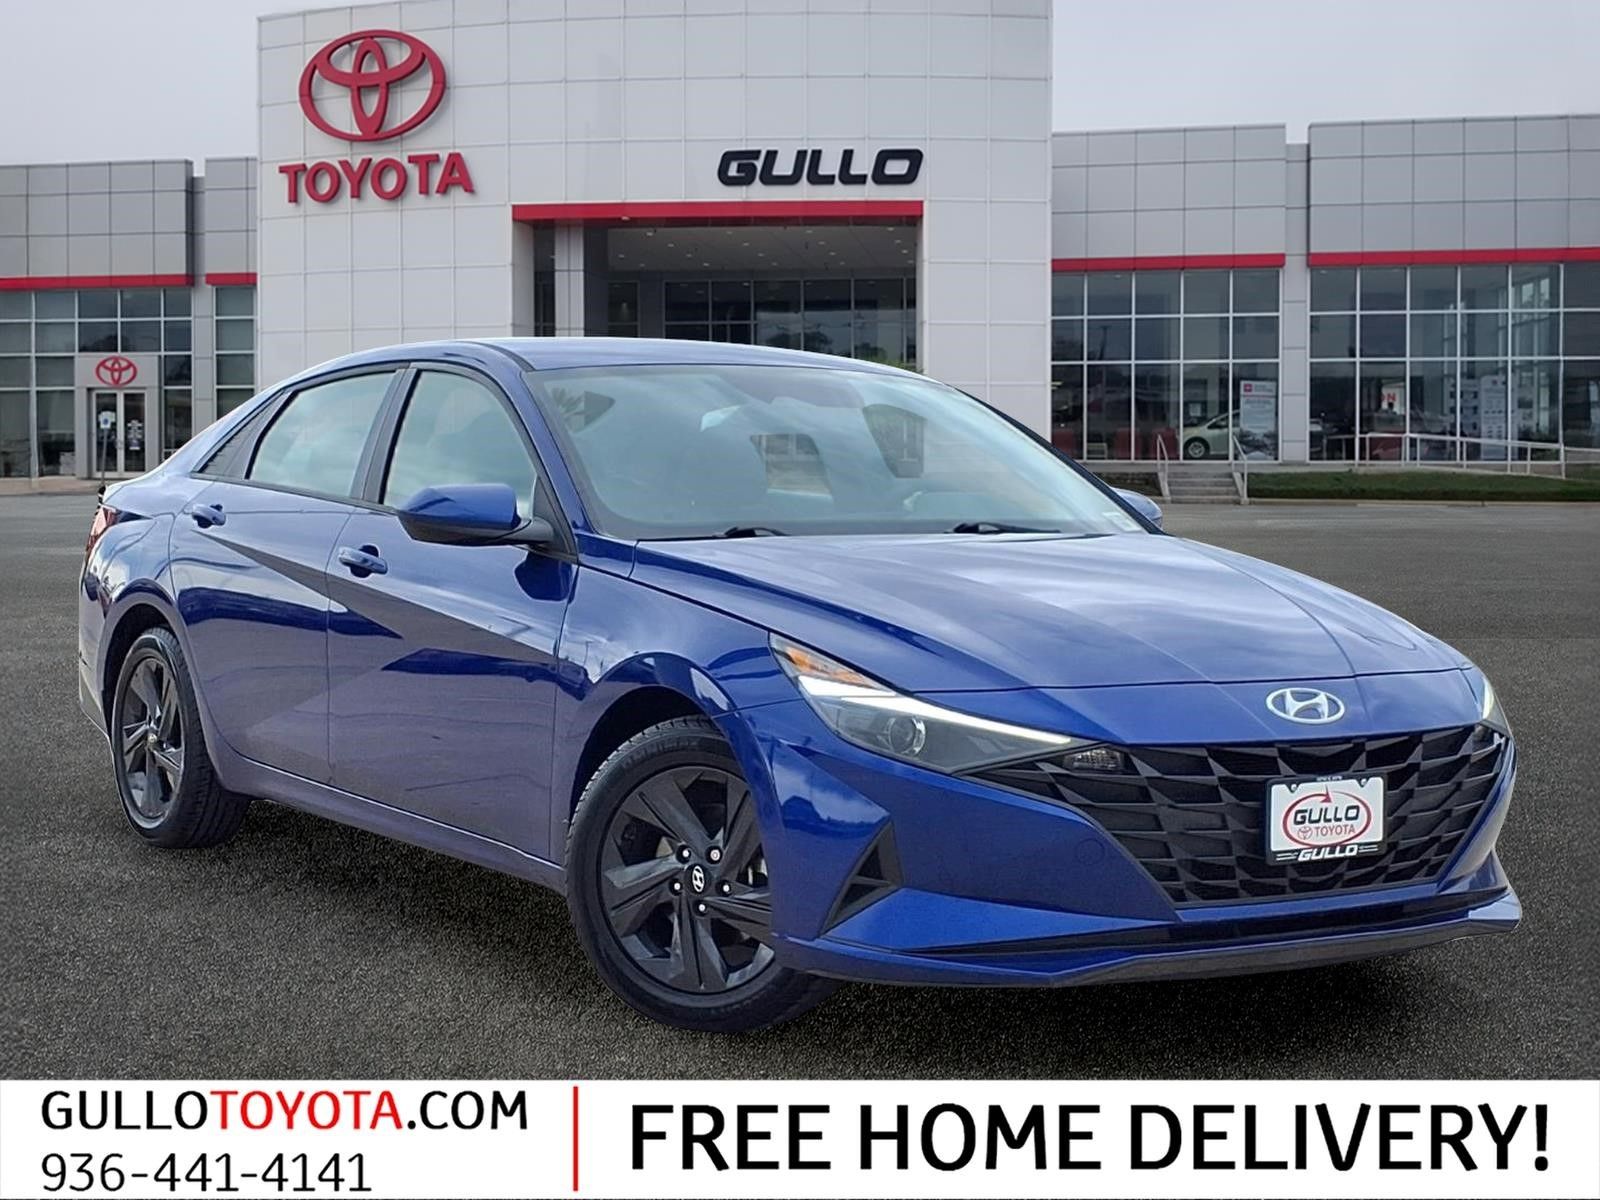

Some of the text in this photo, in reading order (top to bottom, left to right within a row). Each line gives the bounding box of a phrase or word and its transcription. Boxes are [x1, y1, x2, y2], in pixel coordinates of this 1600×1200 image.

[279, 152, 475, 203] TOYOTA
[717, 148, 924, 187] GULLO
[1293, 805, 1360, 825] GULLO
[1314, 824, 1356, 837] TOYOTA
[1297, 844, 1359, 862] GULLO
